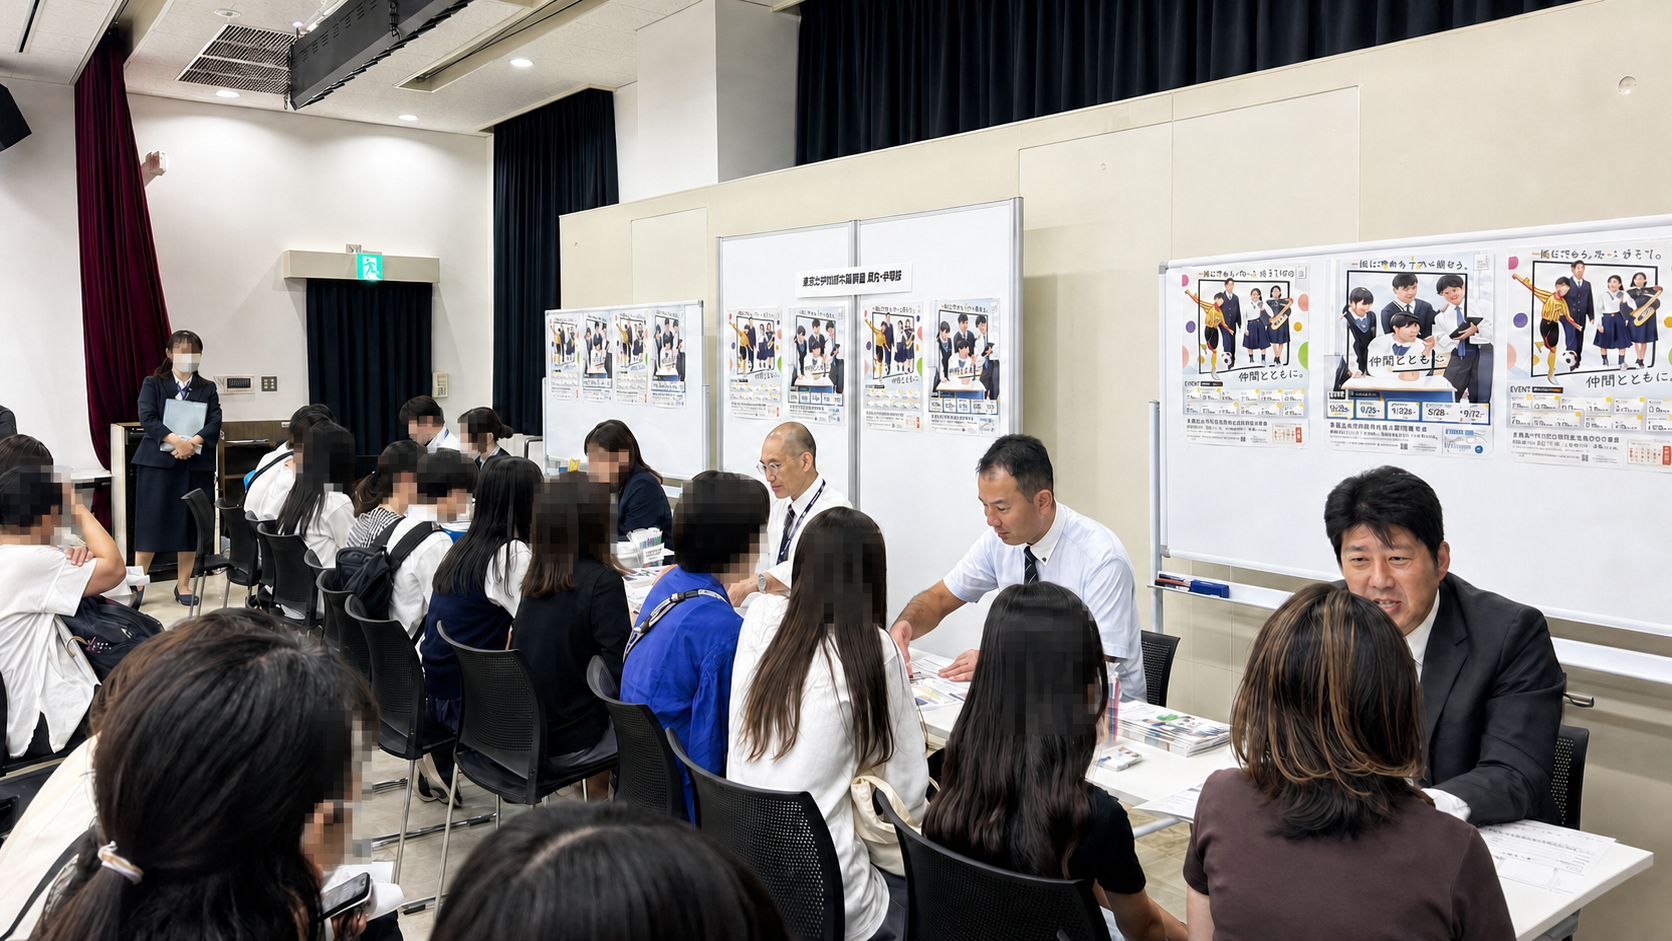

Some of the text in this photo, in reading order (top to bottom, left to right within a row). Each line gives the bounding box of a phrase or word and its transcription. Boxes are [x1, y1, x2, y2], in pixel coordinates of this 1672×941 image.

[1239, 370, 1303, 382] 仲間とともに。
